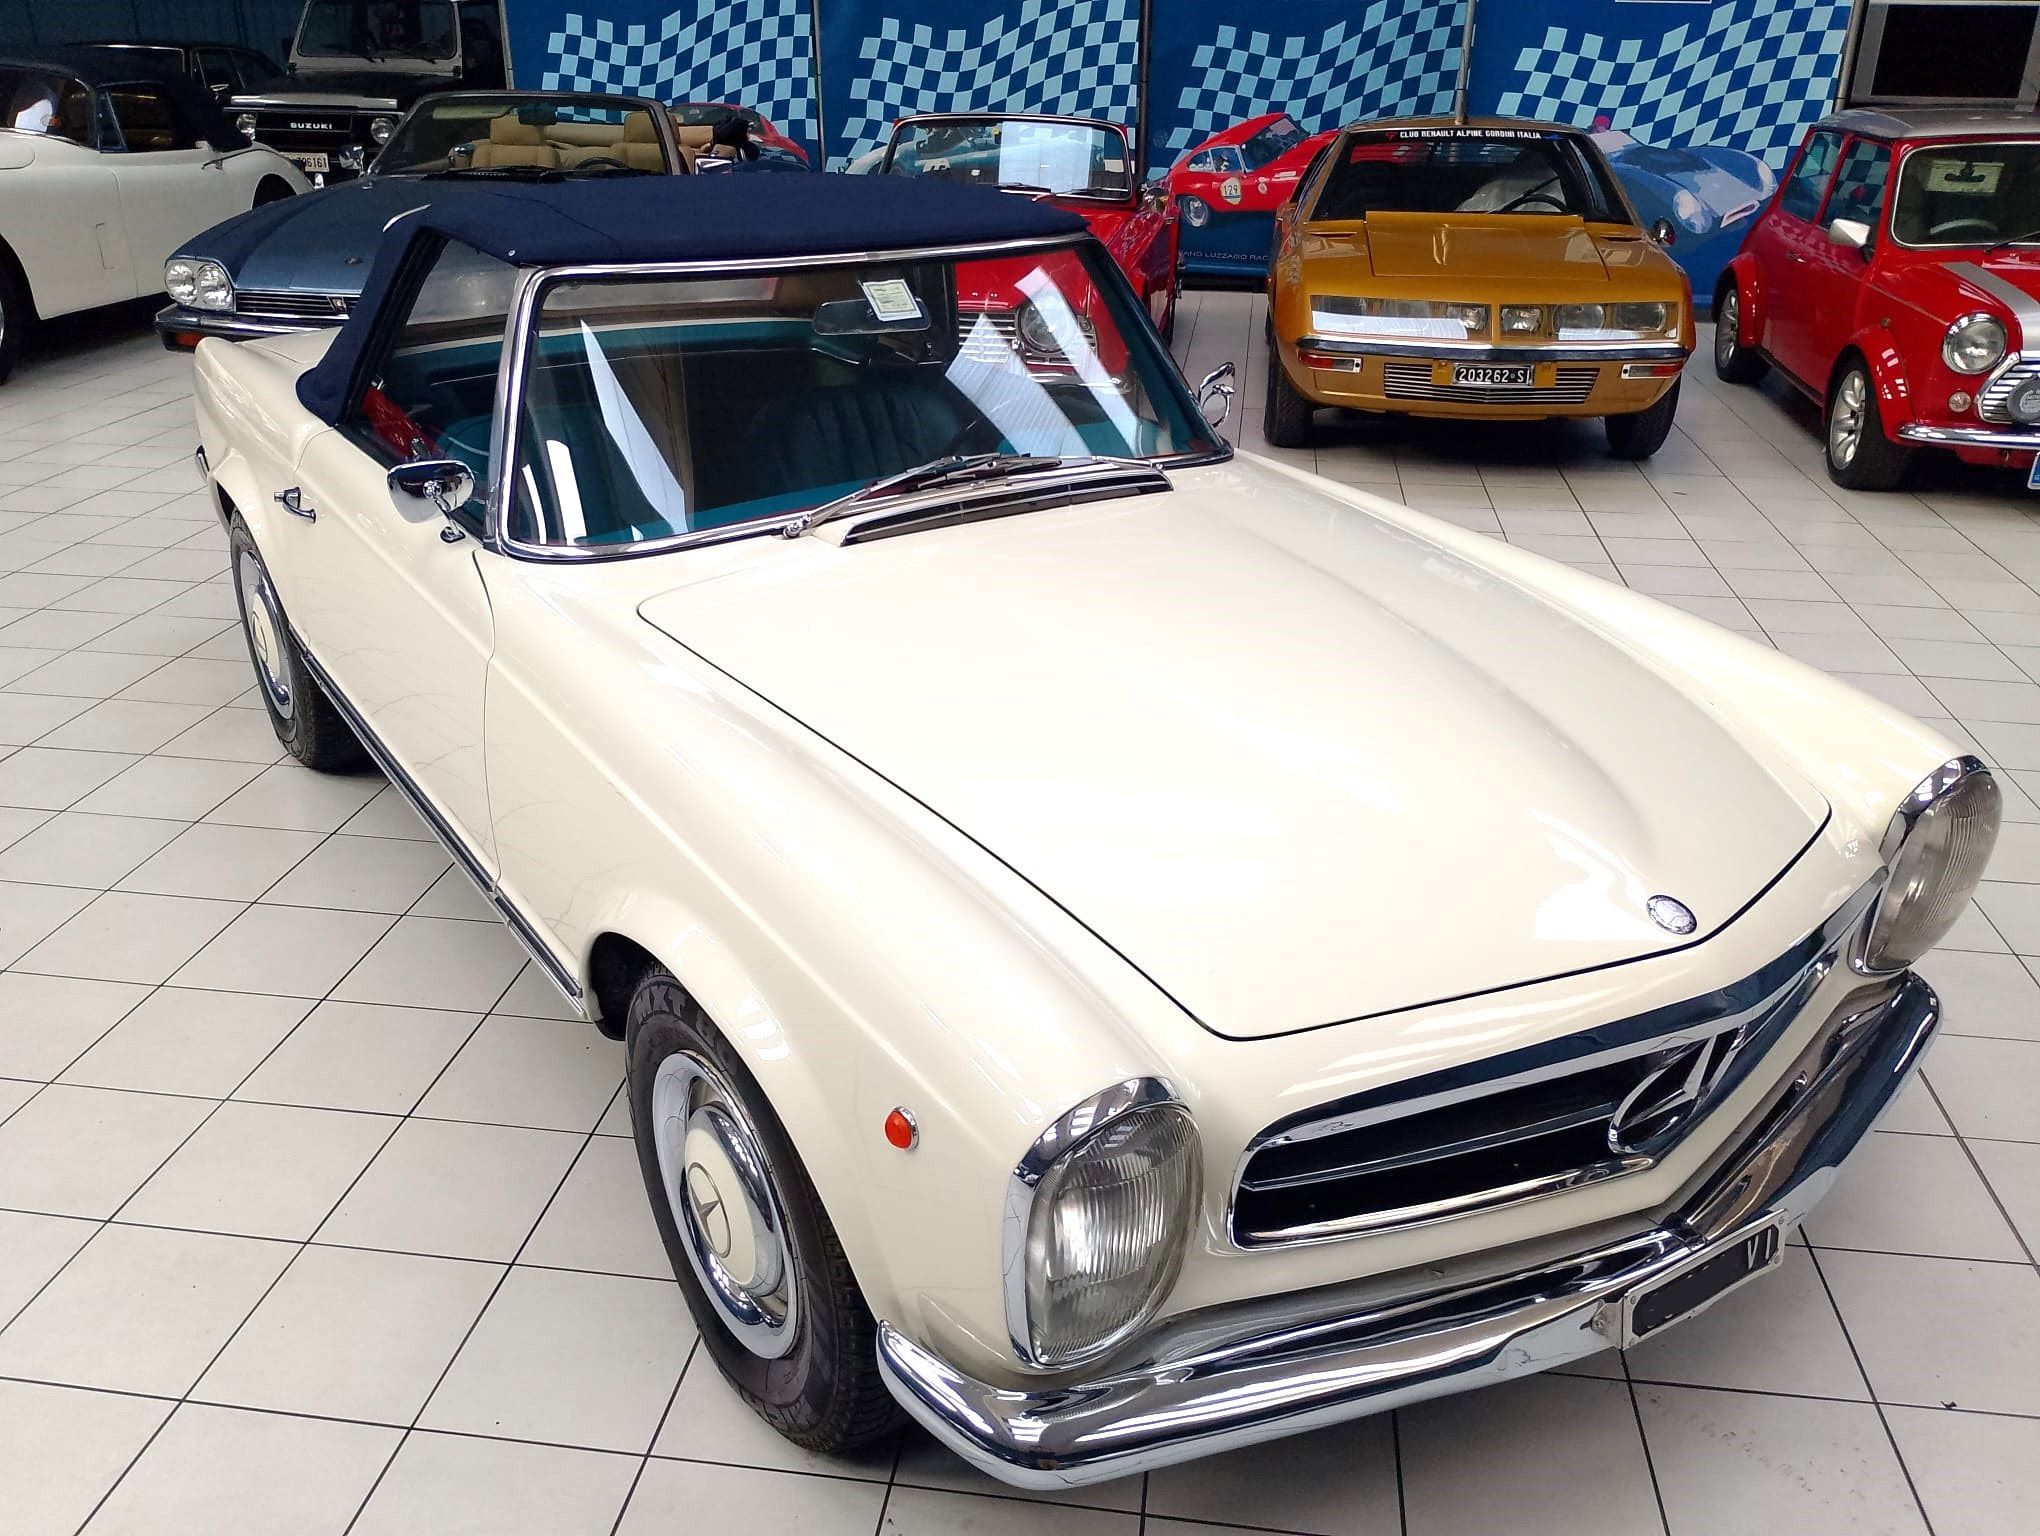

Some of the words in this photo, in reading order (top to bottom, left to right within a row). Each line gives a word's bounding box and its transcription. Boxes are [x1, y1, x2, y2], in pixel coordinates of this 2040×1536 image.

[290, 122, 333, 130] SUZUKI
[1400, 131, 1419, 139] CLUB
[1421, 130, 1454, 138] RENAULT
[1456, 129, 1483, 137] ALPINE
[1485, 130, 1515, 138] GORDINI
[1516, 130, 1541, 140] ITALIA
[1223, 184, 1238, 195] 129
[1459, 368, 1509, 383] 203262
[1747, 1228, 1772, 1270] VI
